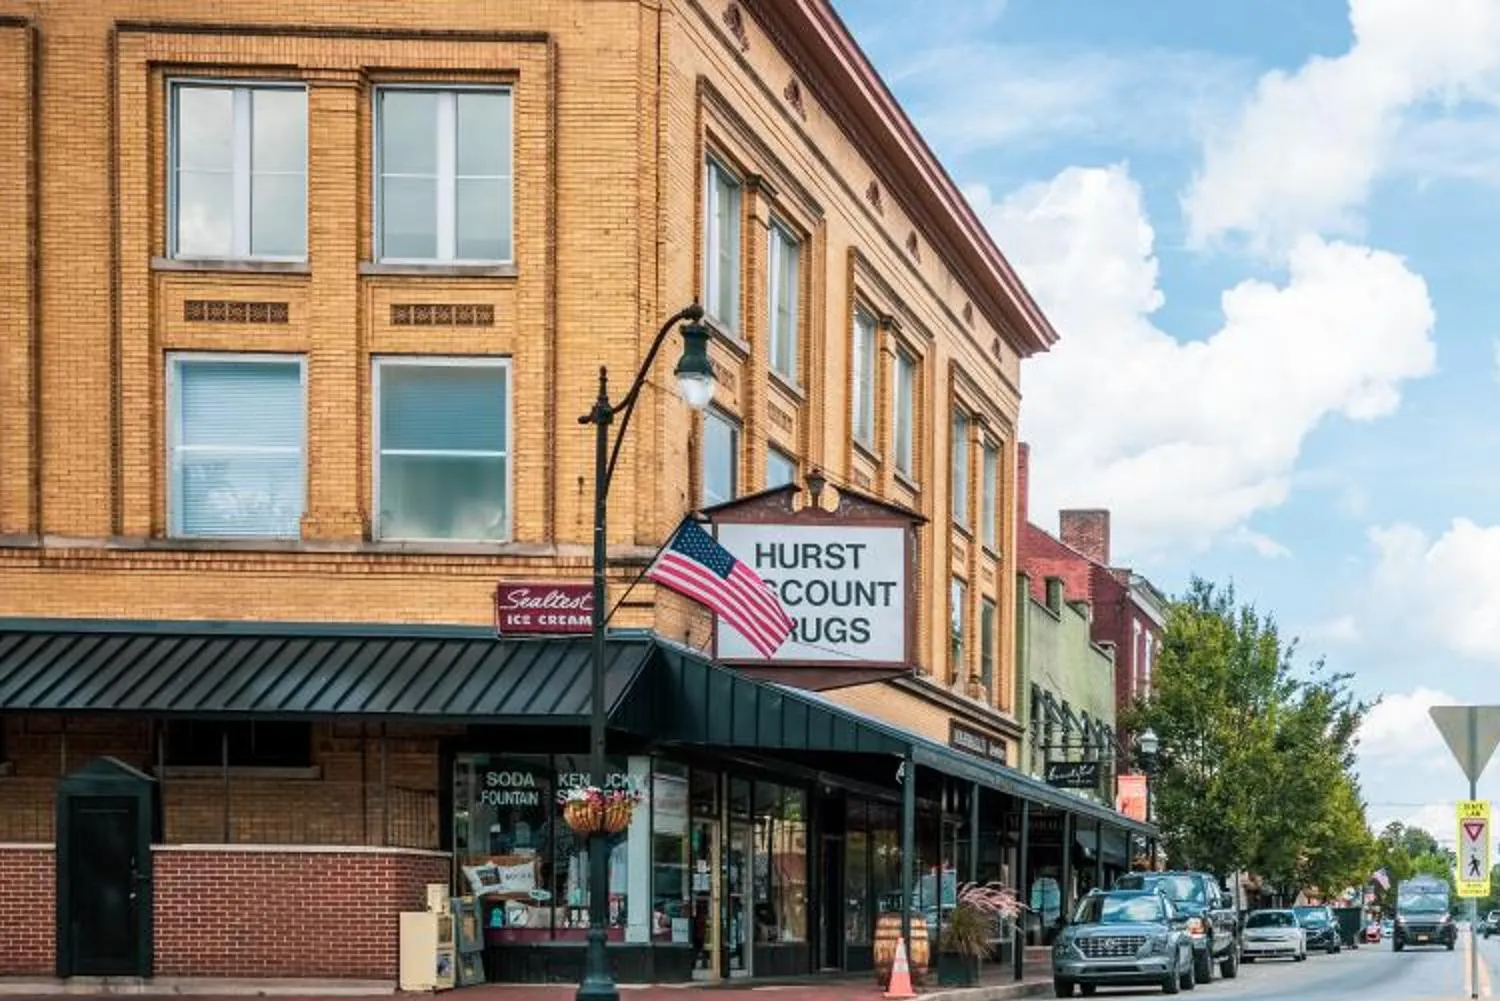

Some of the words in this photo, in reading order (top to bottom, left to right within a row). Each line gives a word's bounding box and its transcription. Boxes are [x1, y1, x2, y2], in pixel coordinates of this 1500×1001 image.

[755, 543, 866, 569] HURST
[501, 588, 594, 610] Sealtest
[762, 579, 897, 607] COUNT
[507, 615, 531, 625] ICE
[538, 615, 592, 626] CREAM
[788, 617, 871, 644] UGS
[486, 772, 535, 787] SODA
[481, 790, 539, 806] FOUNTAIN
